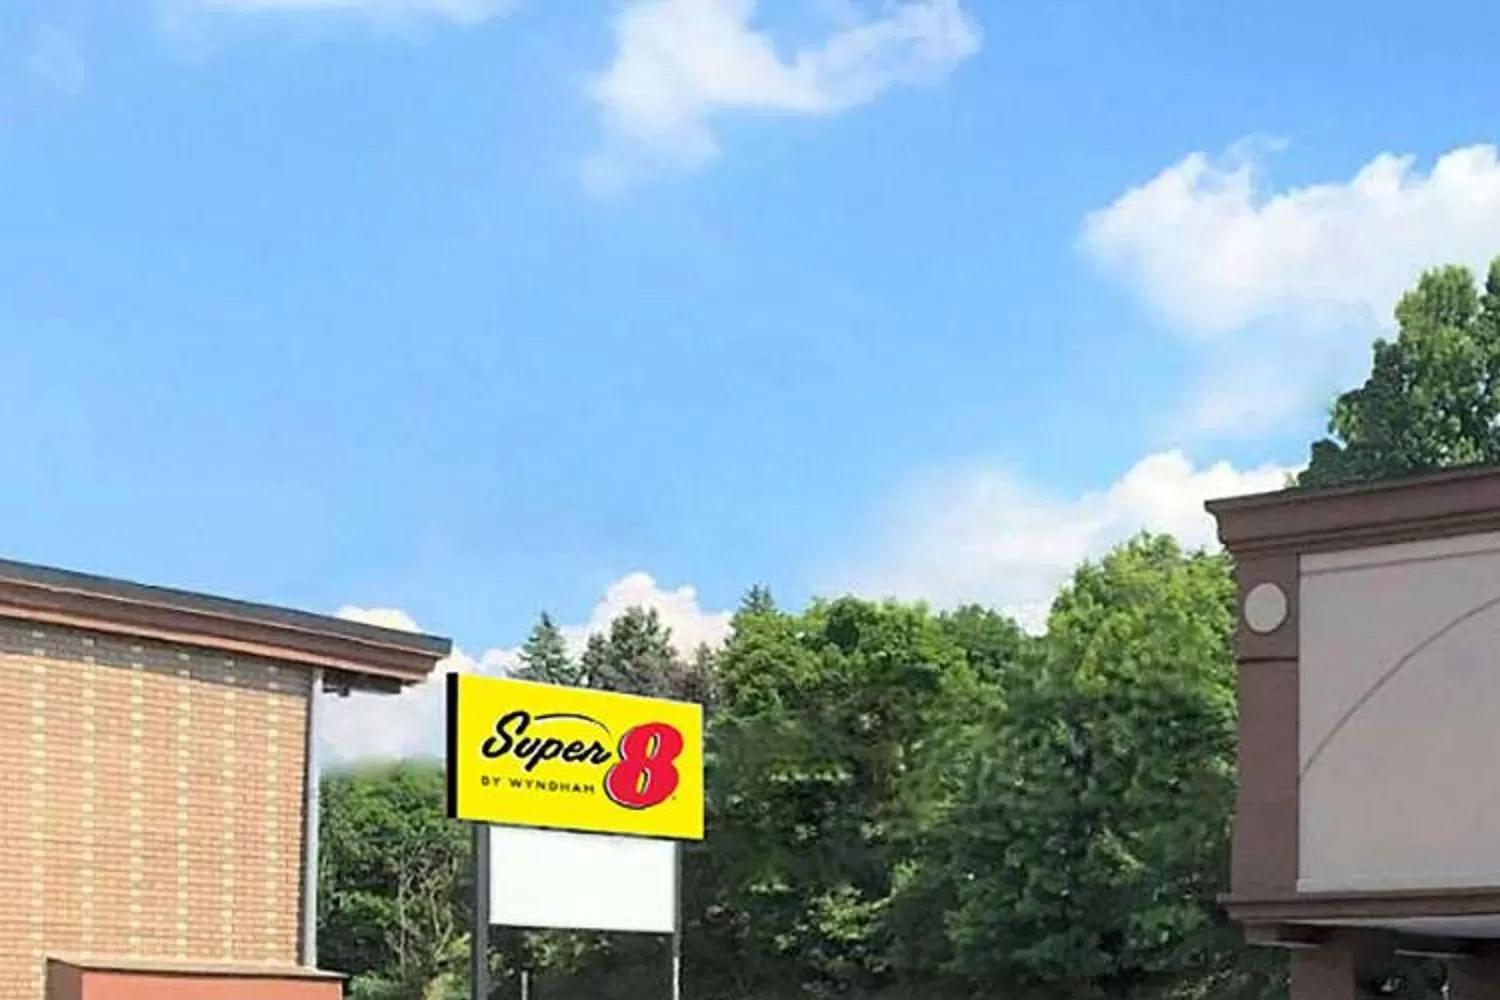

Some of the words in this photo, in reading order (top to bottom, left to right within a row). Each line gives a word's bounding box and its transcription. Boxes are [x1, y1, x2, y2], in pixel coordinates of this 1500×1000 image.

[481, 711, 612, 772] Super
[604, 722, 683, 809] 8
[481, 775, 502, 788] BY
[508, 777, 596, 793] WYNDHAM
